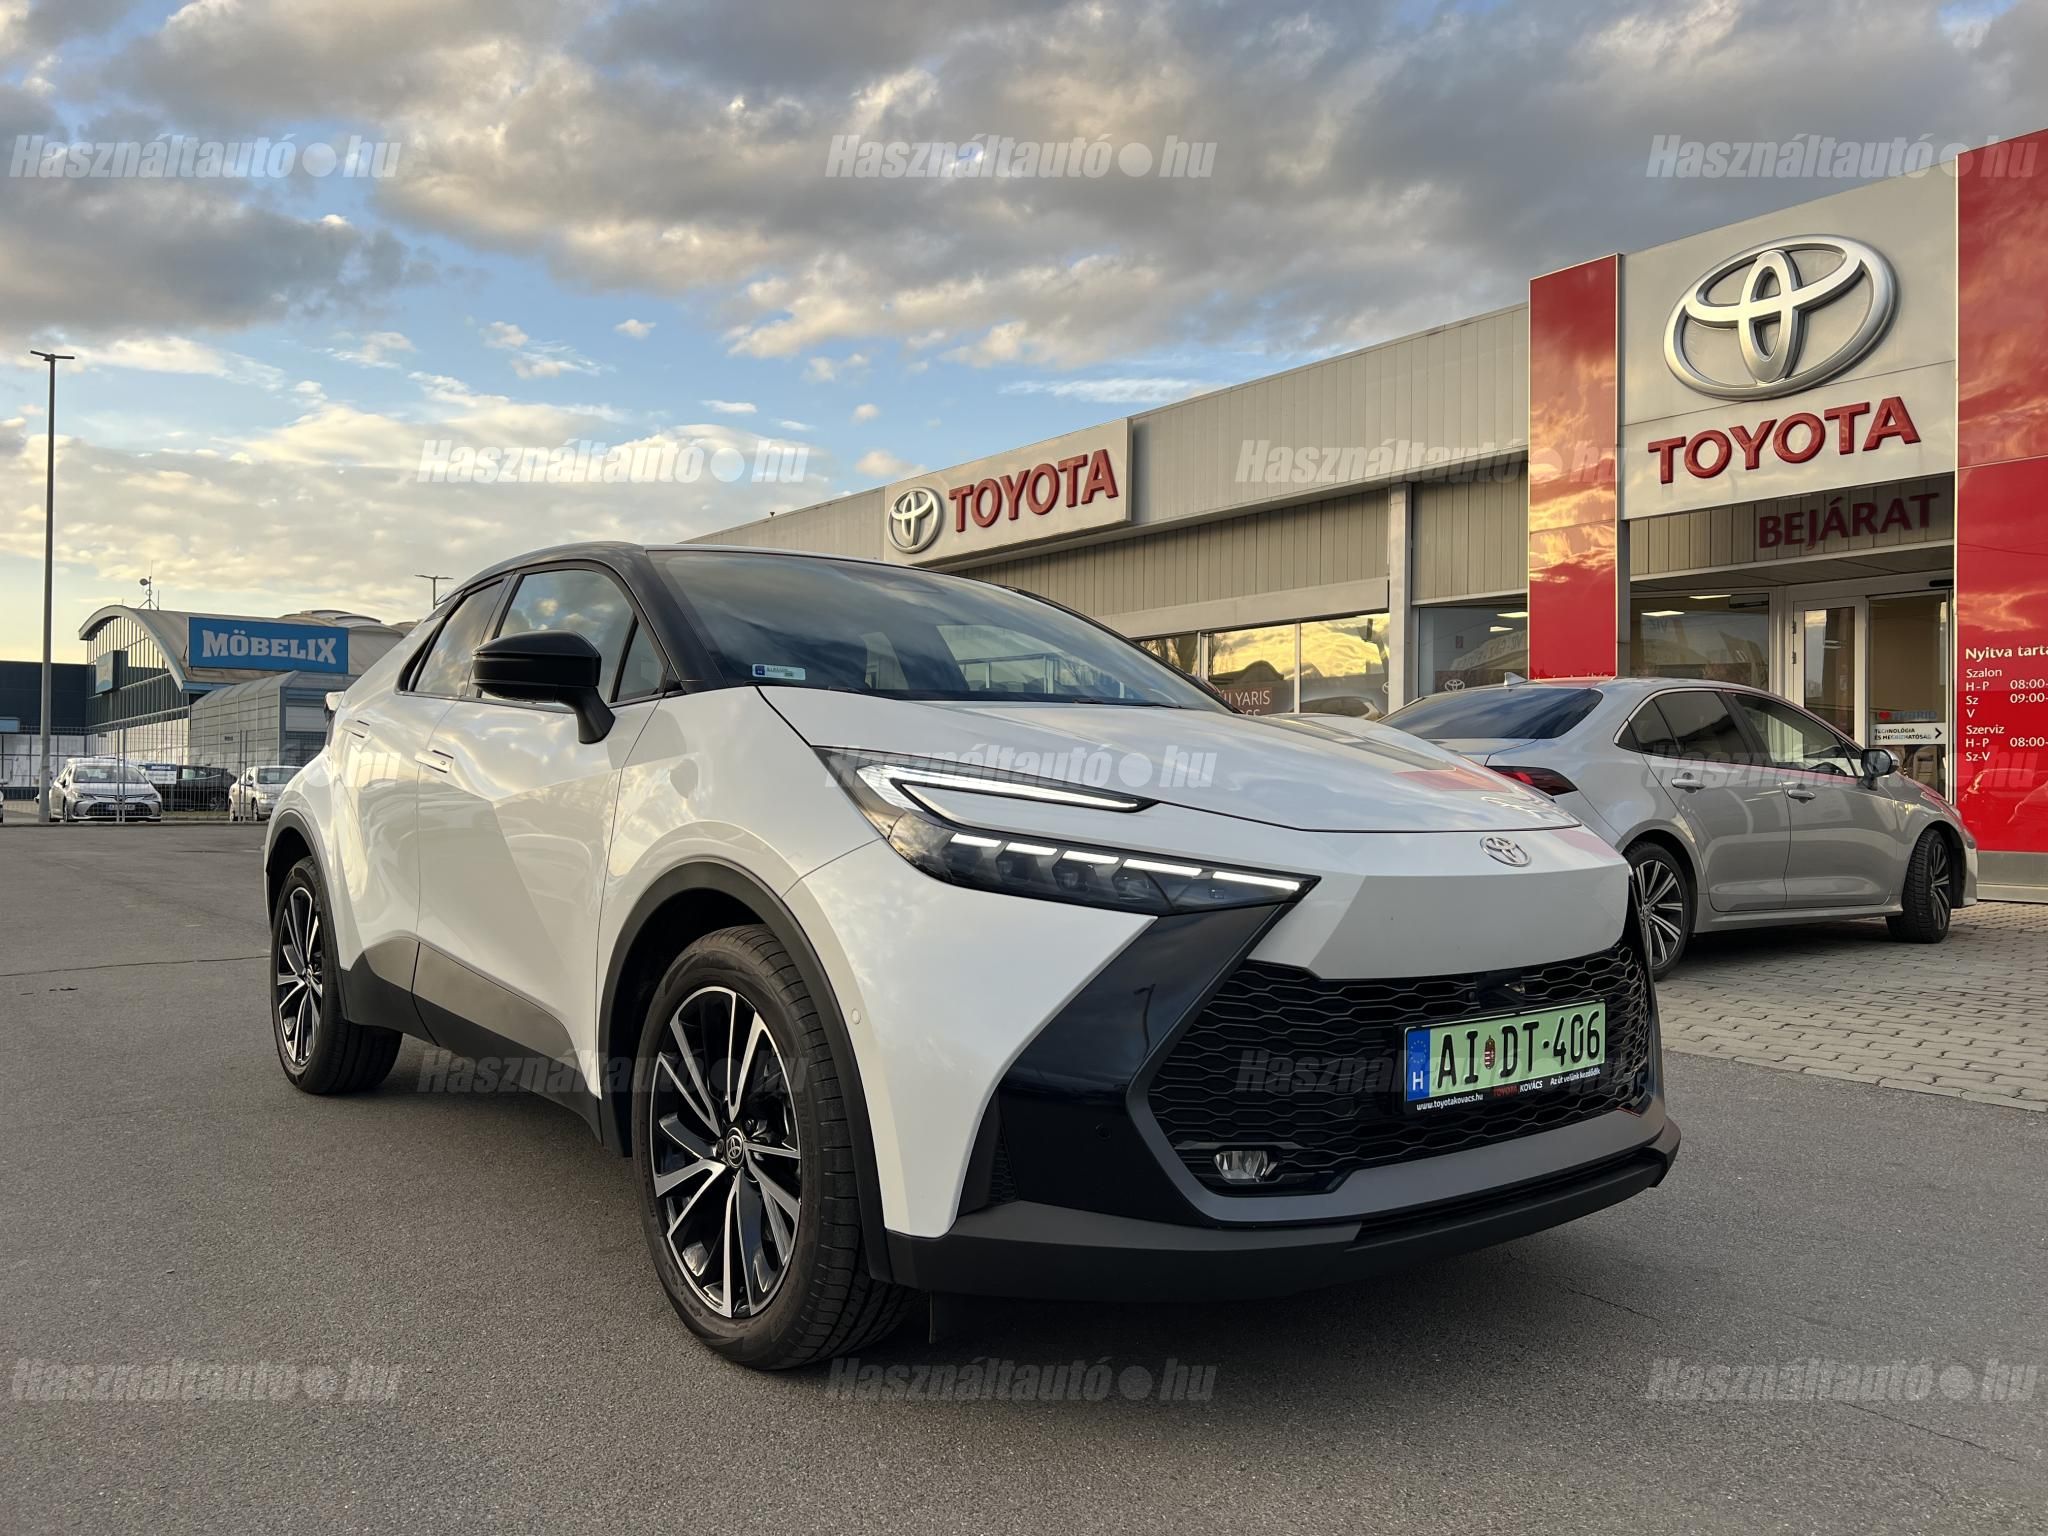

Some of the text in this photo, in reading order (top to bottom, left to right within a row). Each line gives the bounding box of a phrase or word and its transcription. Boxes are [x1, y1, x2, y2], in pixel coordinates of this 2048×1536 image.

[1648, 396, 1921, 484] TOYOTA
[949, 449, 1118, 532] TOYOTA
[1759, 496, 1939, 548] BEJÁRAT
[202, 629, 336, 664] MÖBELIX
[1965, 647, 2012, 662] Nyitva
[1966, 668, 2002, 678] Szalon
[1235, 690, 1271, 706] YARIS
[1966, 695, 1979, 705] Sz
[1966, 709, 1975, 718] V
[1966, 724, 2005, 734] Szerviz
[1966, 751, 1990, 762] Sz-V
[1413, 1070, 1424, 1091] H
[1416, 1093, 1484, 1111] www.toyotakovacs.hu
[1520, 1081, 1543, 1093] KOVÁCS
